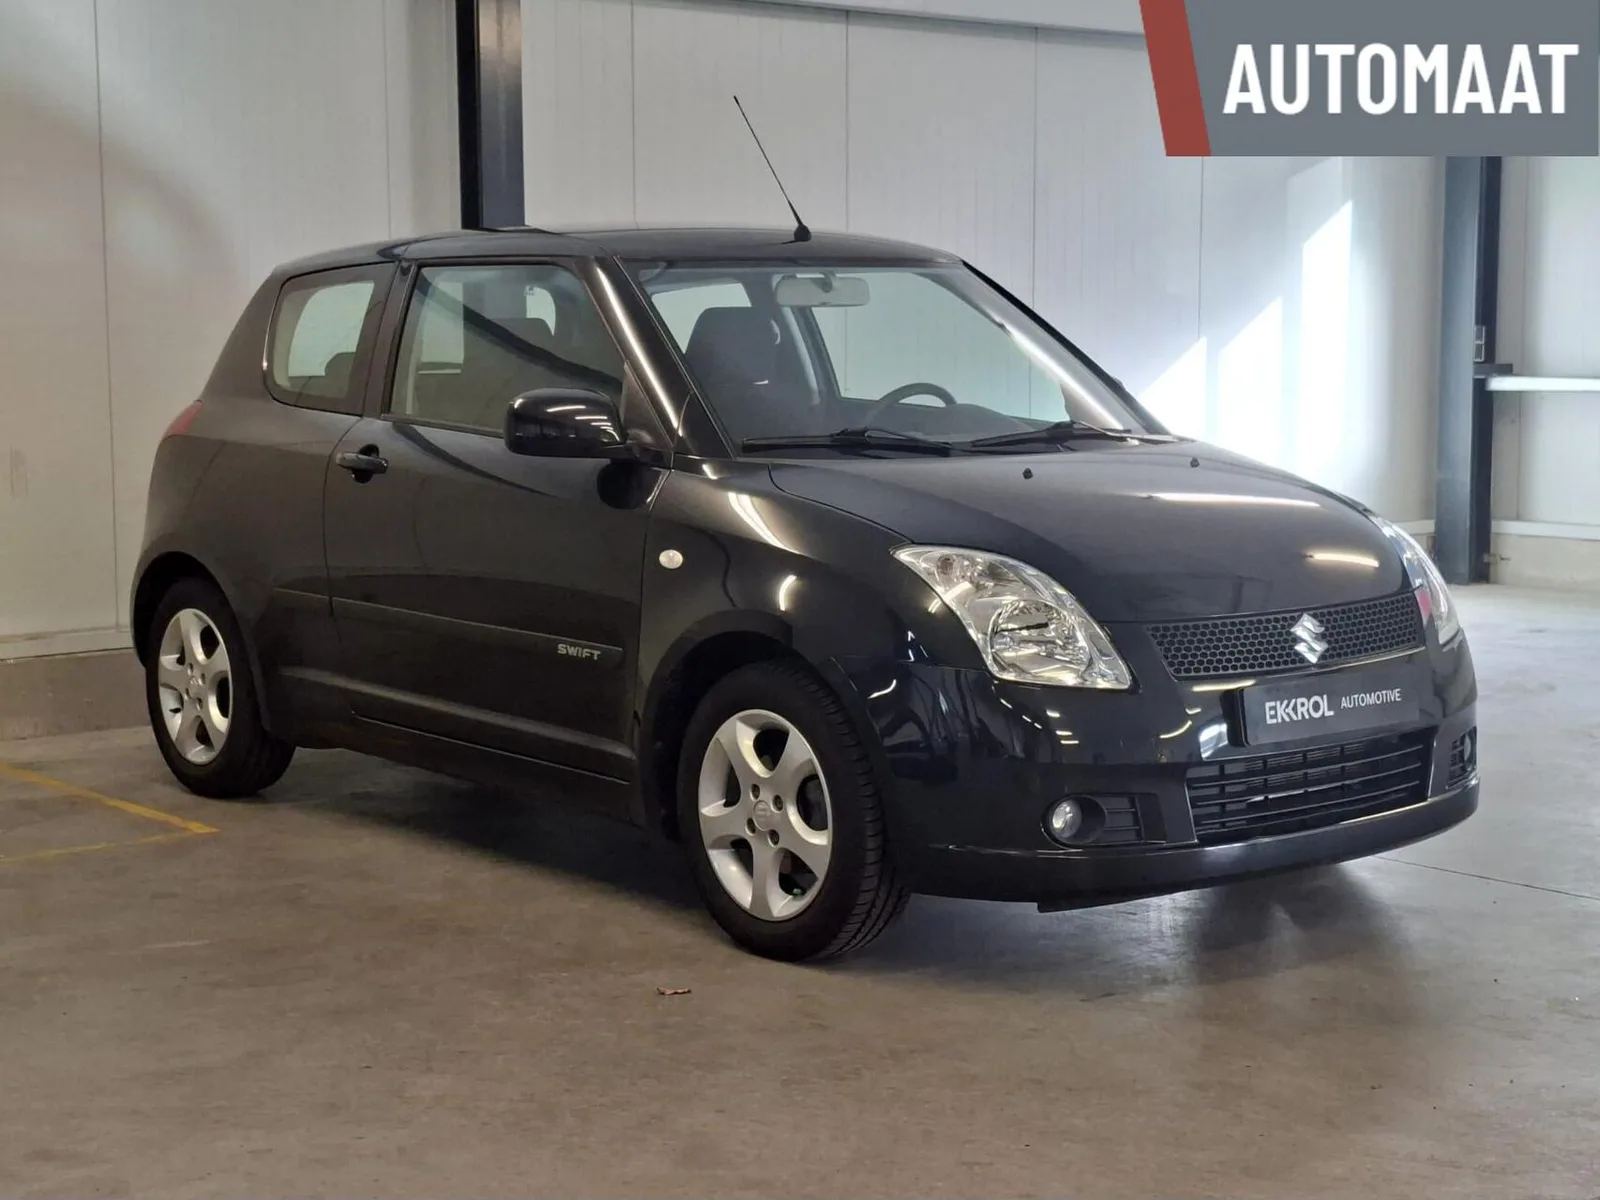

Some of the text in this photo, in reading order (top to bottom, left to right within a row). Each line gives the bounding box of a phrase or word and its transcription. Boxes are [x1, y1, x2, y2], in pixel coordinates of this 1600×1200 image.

[557, 643, 601, 660] SWIFT
[1265, 688, 1402, 724] EKKROL AUTOMOTIVE
